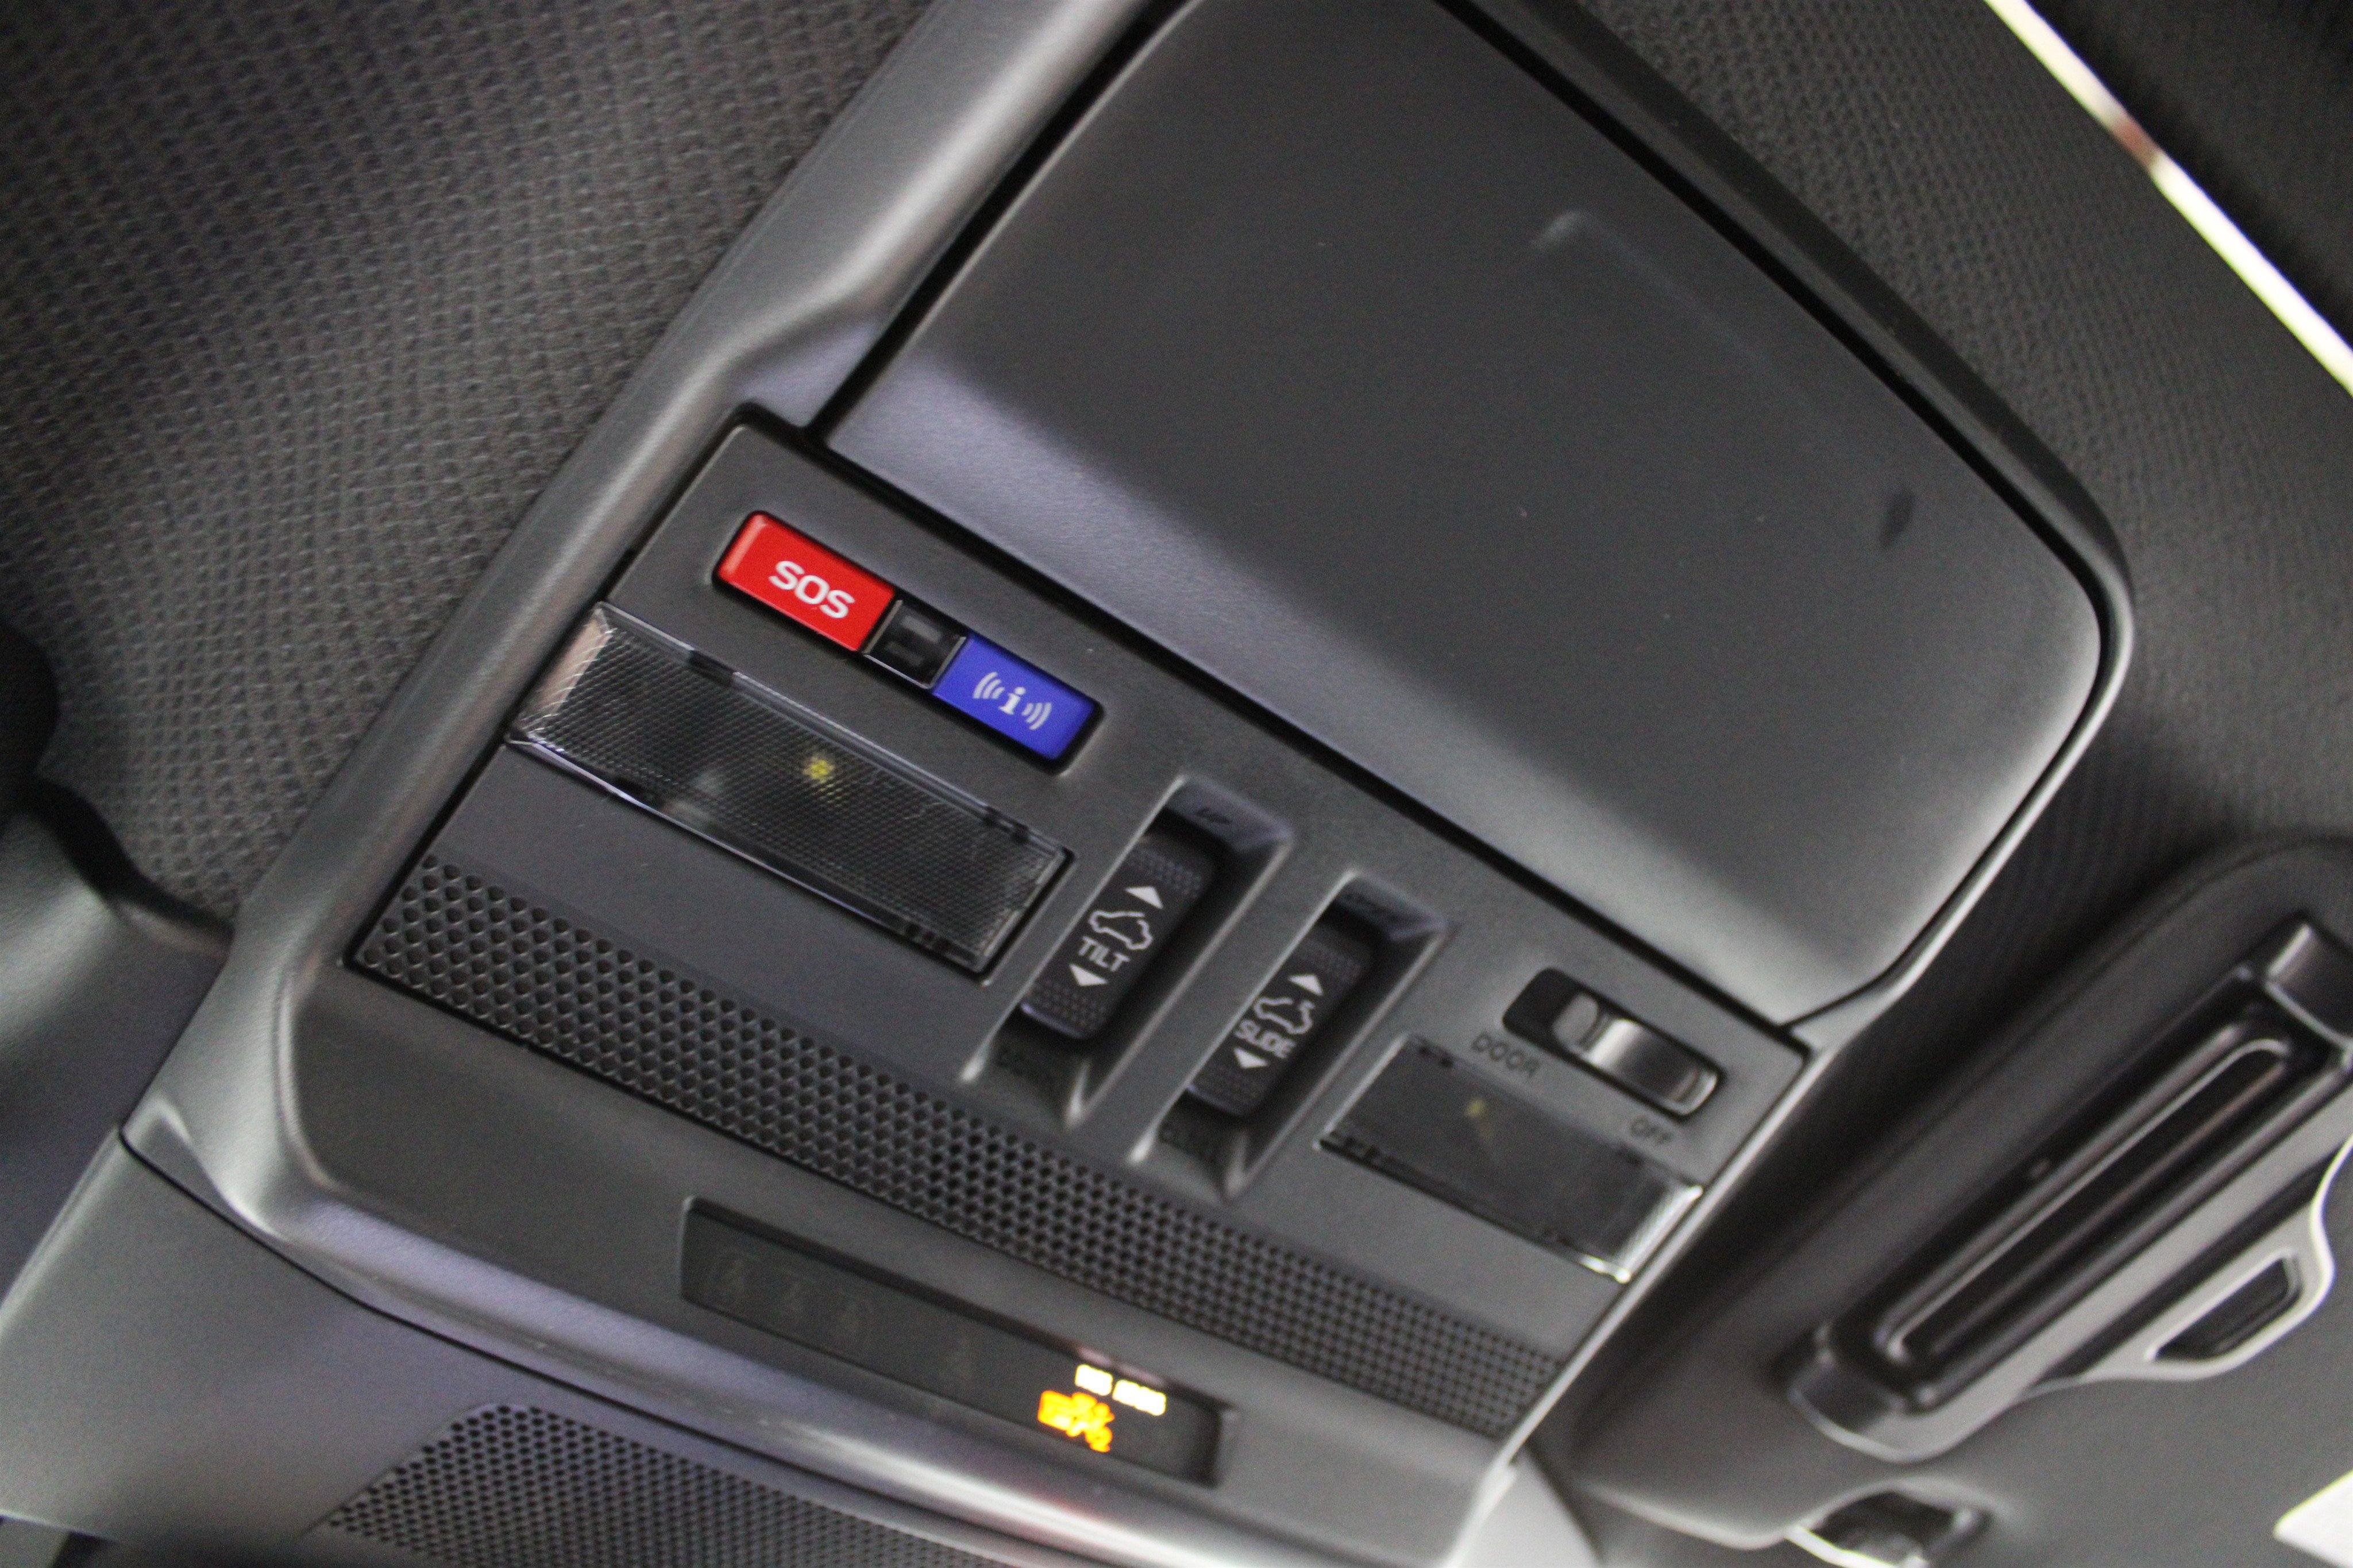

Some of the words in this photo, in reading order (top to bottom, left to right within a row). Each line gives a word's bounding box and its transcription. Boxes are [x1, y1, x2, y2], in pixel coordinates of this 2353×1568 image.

[768, 560, 855, 619] SOS
[1078, 936, 1130, 972] TILT
[1235, 1019, 1295, 1059] SLIDE
[1471, 1033, 1540, 1077] DOOR
[1630, 1117, 1673, 1147] OFF
